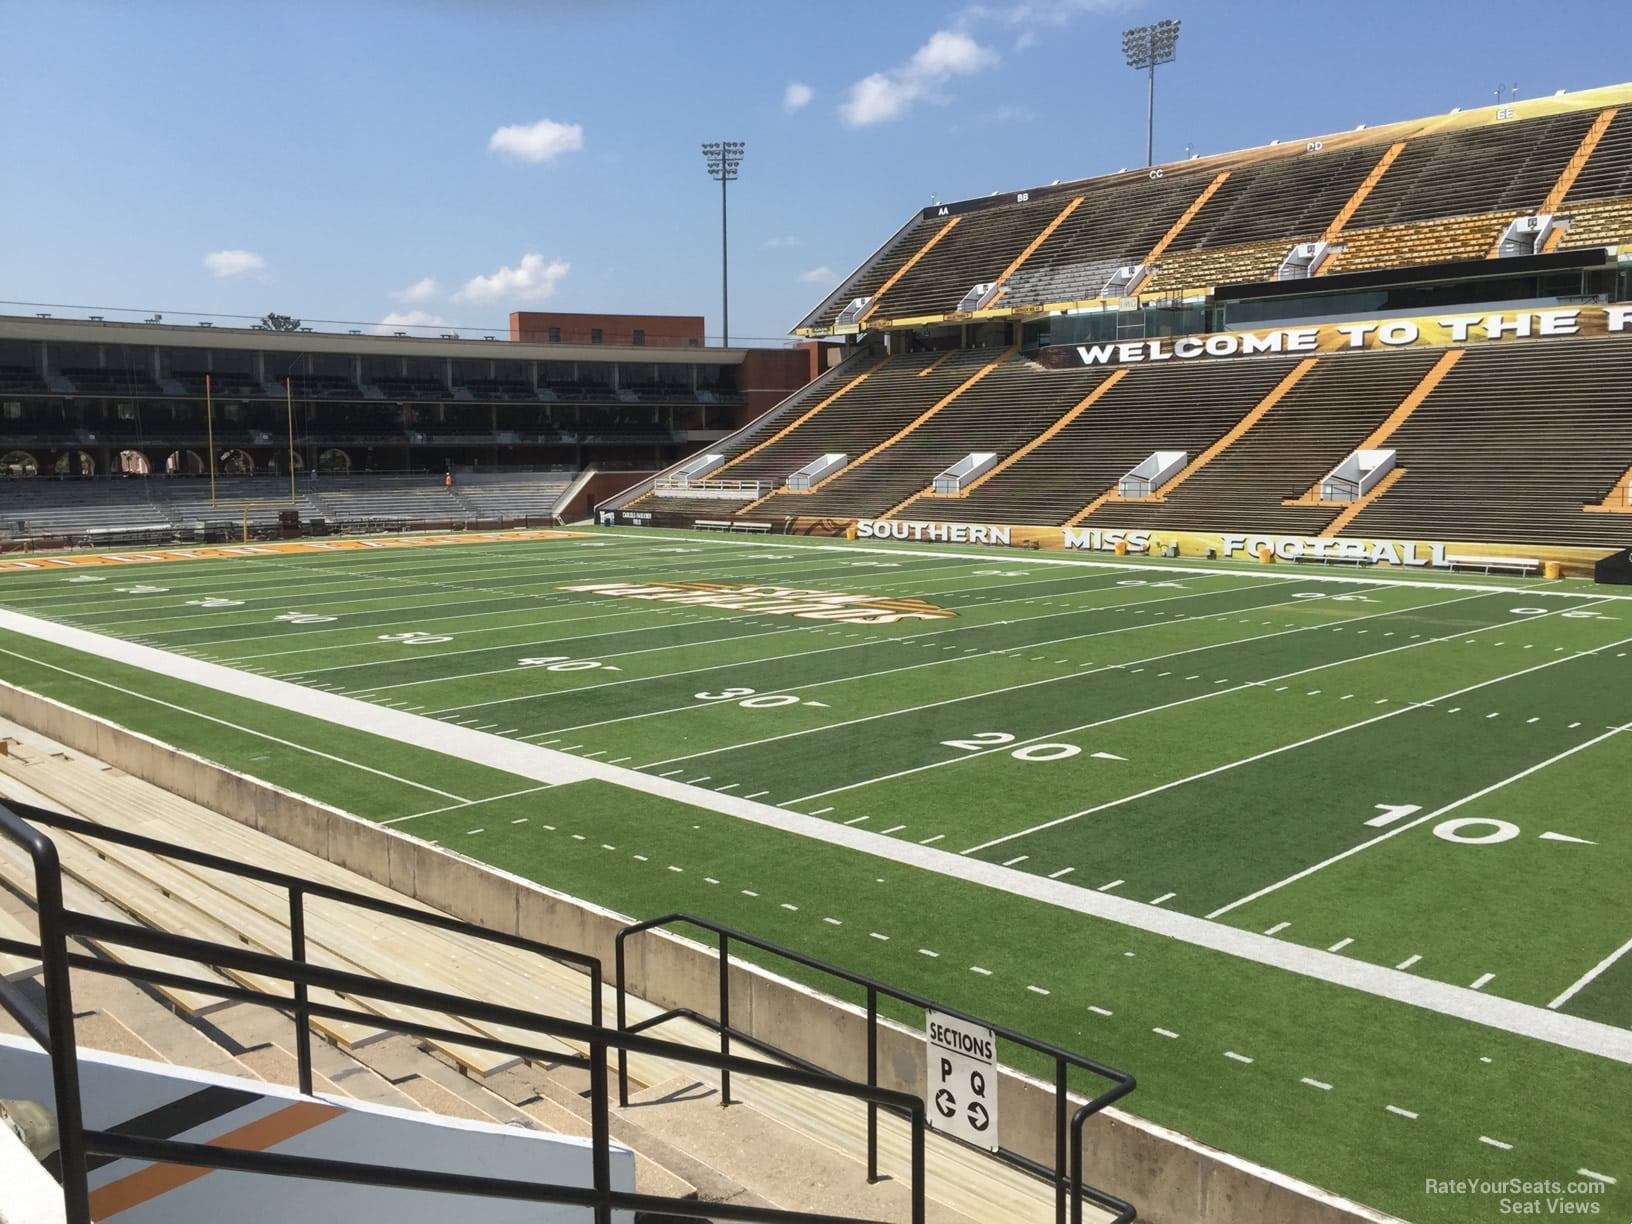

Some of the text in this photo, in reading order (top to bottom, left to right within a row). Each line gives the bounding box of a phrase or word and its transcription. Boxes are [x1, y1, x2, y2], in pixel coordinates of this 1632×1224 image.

[1497, 109, 1514, 121] EE
[938, 207, 949, 217] AA
[1077, 328, 1320, 365] WELCOME
[1338, 321, 1419, 347] TO
[1438, 309, 1582, 340] THE
[856, 519, 1452, 567] SOUTHERN MISS FOOTBALL
[516, 656, 602, 673] 40
[694, 687, 801, 709] 30
[941, 732, 1083, 762] 20
[1363, 803, 1521, 844] 10
[930, 1022, 993, 1060] SECTIONS
[940, 1057, 986, 1098] P Q
